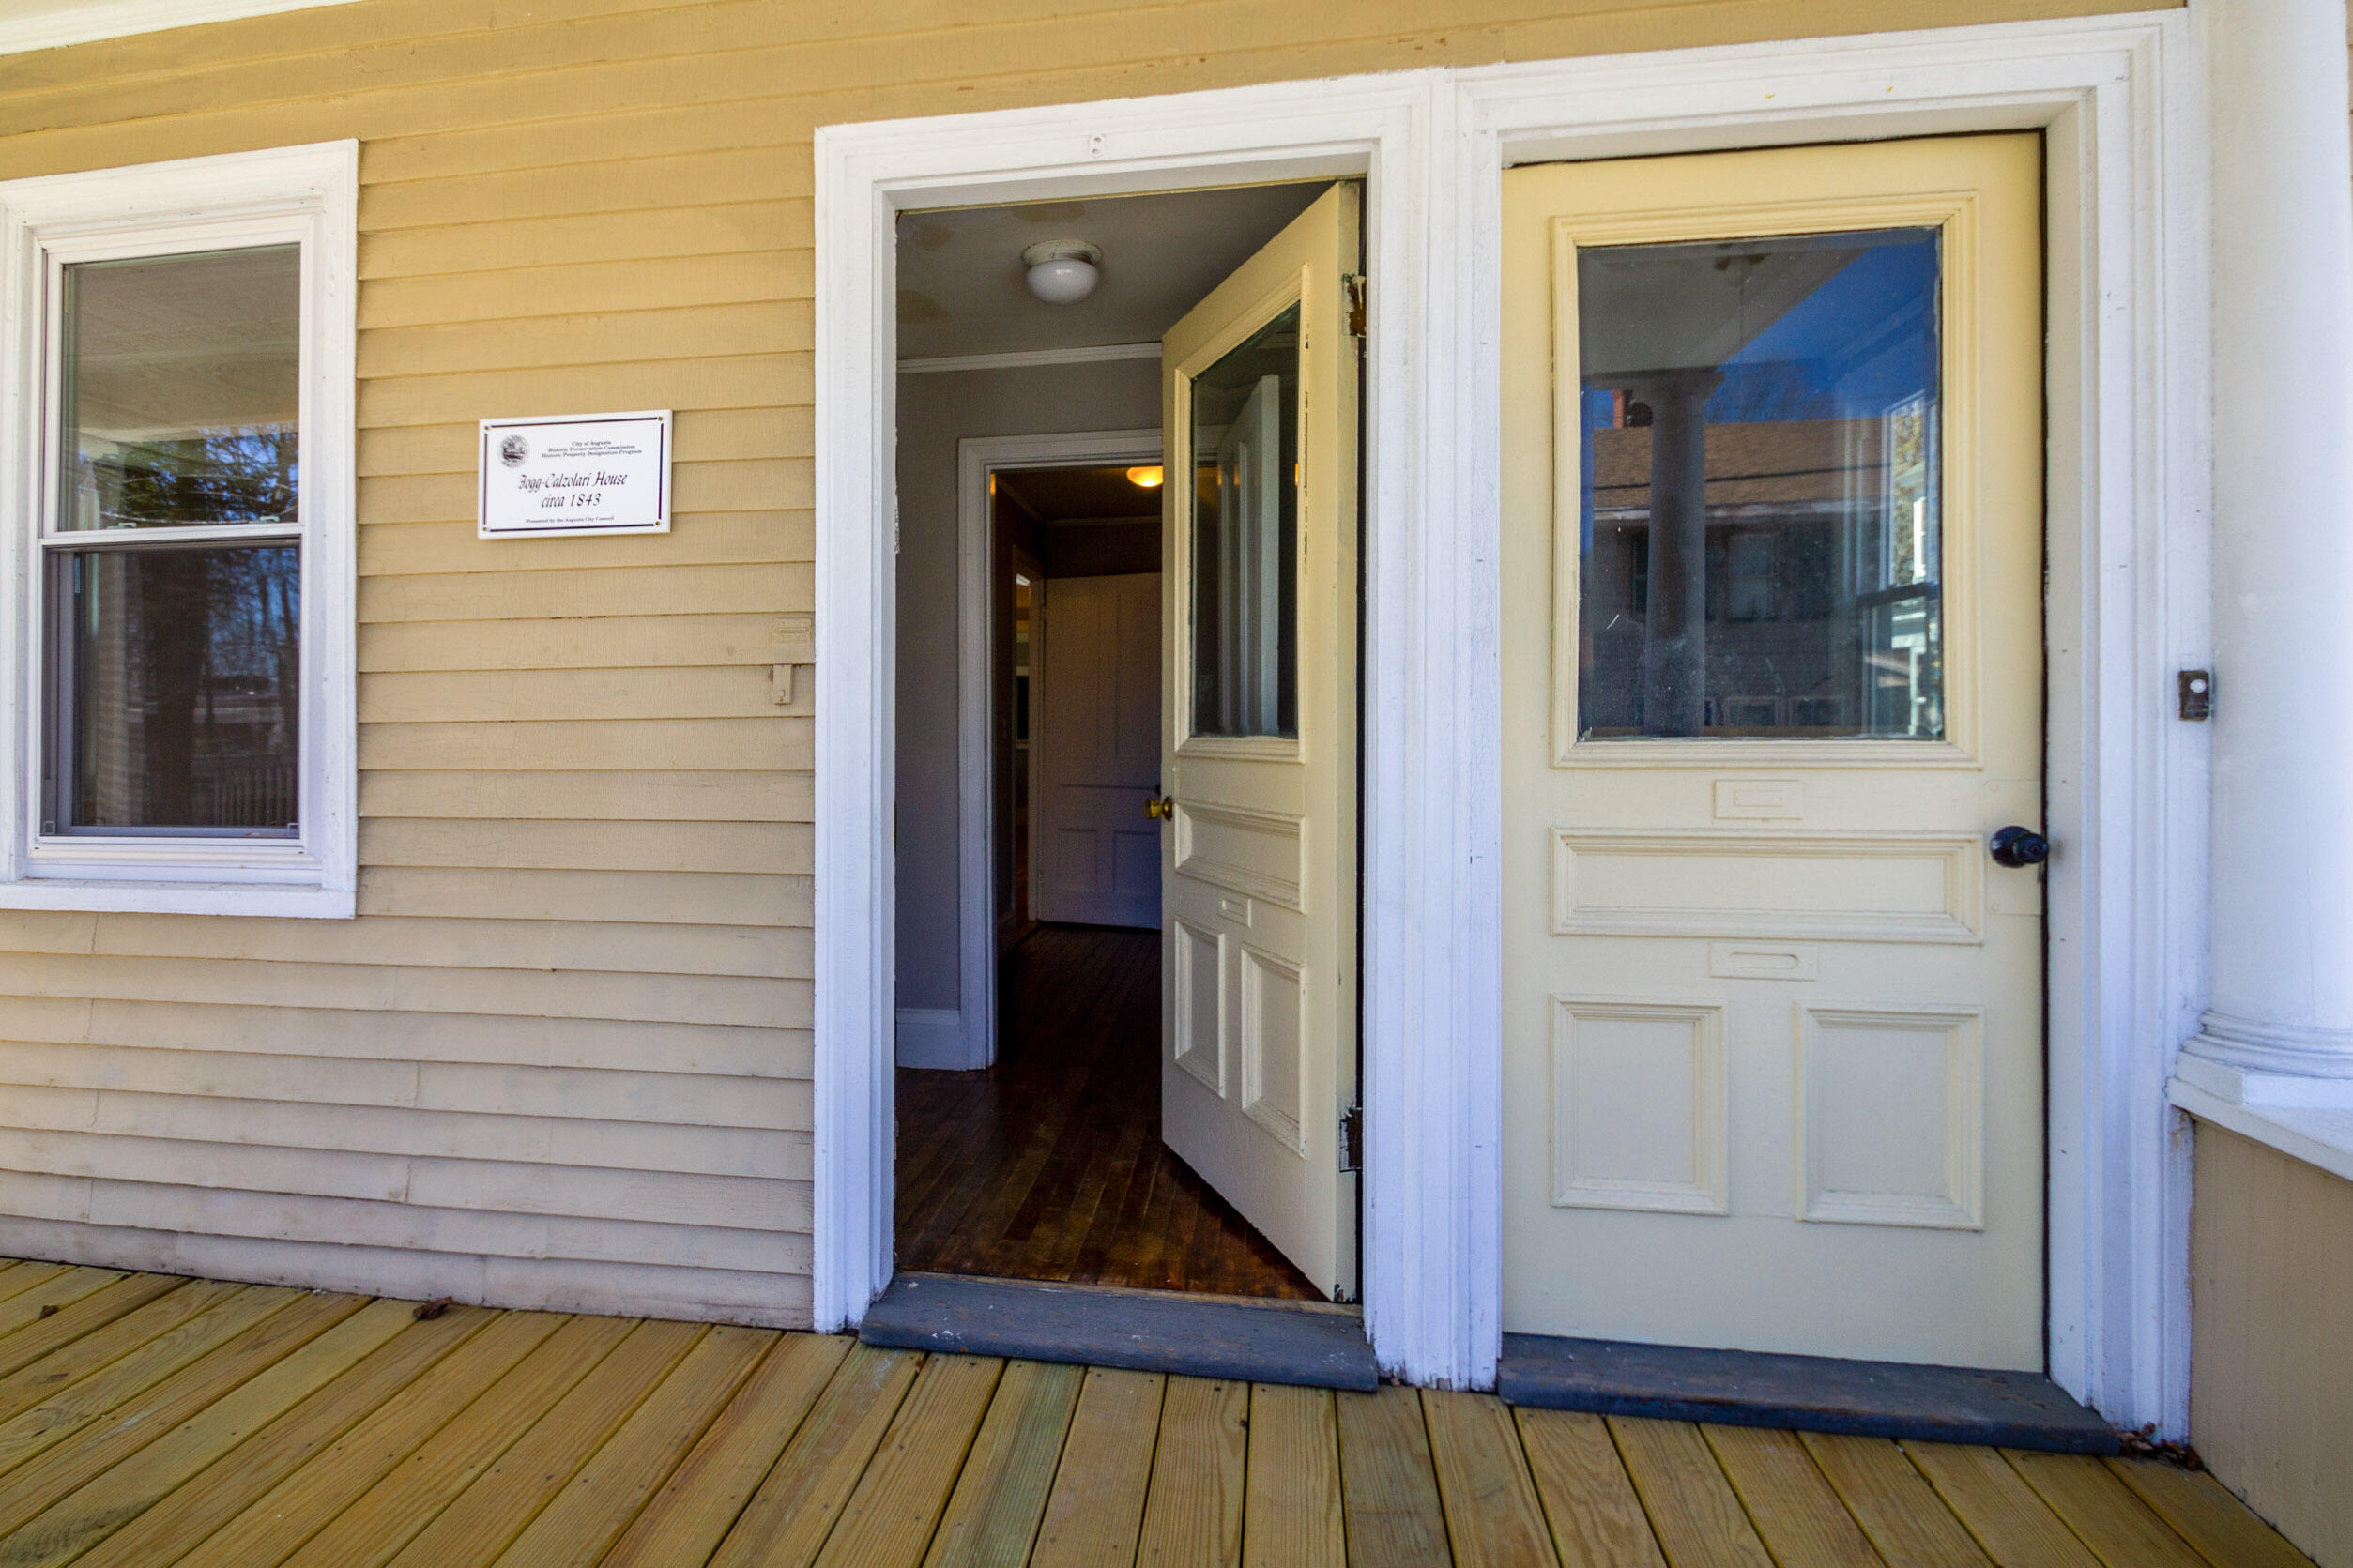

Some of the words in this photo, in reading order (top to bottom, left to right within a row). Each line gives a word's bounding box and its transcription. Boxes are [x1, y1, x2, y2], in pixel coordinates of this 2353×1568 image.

[592, 471, 628, 487] House
[541, 494, 565, 509] circa
[570, 493, 602, 507] 1843
